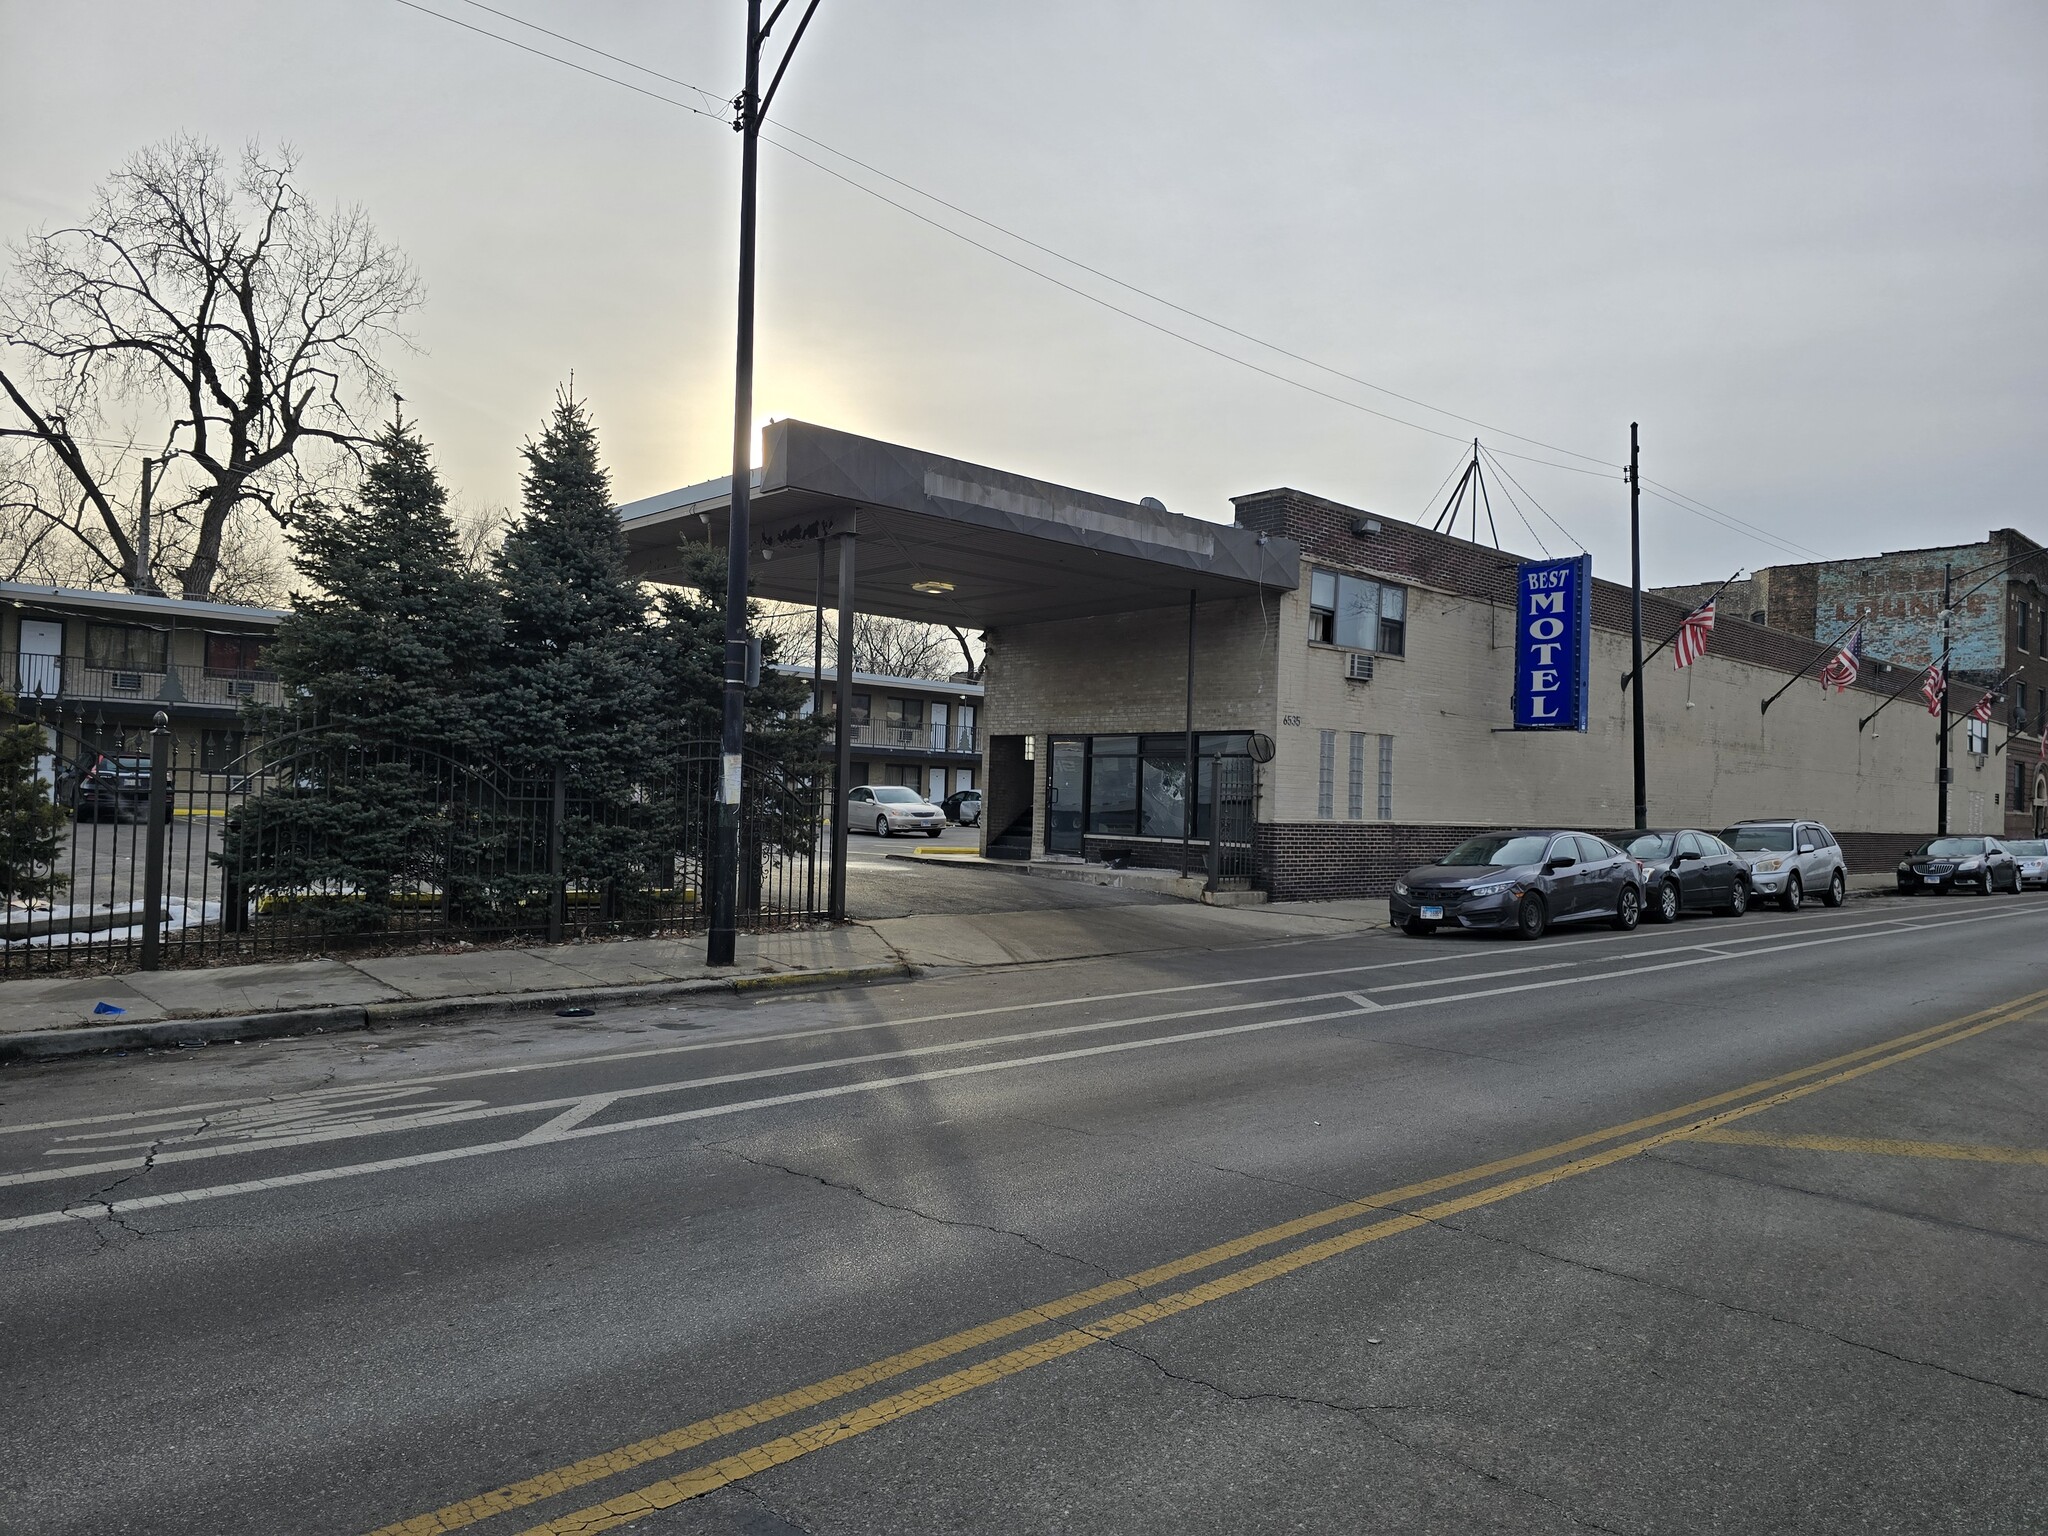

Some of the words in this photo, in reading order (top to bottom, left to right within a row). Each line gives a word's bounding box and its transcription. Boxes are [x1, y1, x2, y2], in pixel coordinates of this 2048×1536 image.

[1528, 569, 1569, 590] BEST
[1529, 591, 1566, 718] MOTEL
[1283, 715, 1300, 727] 6535
